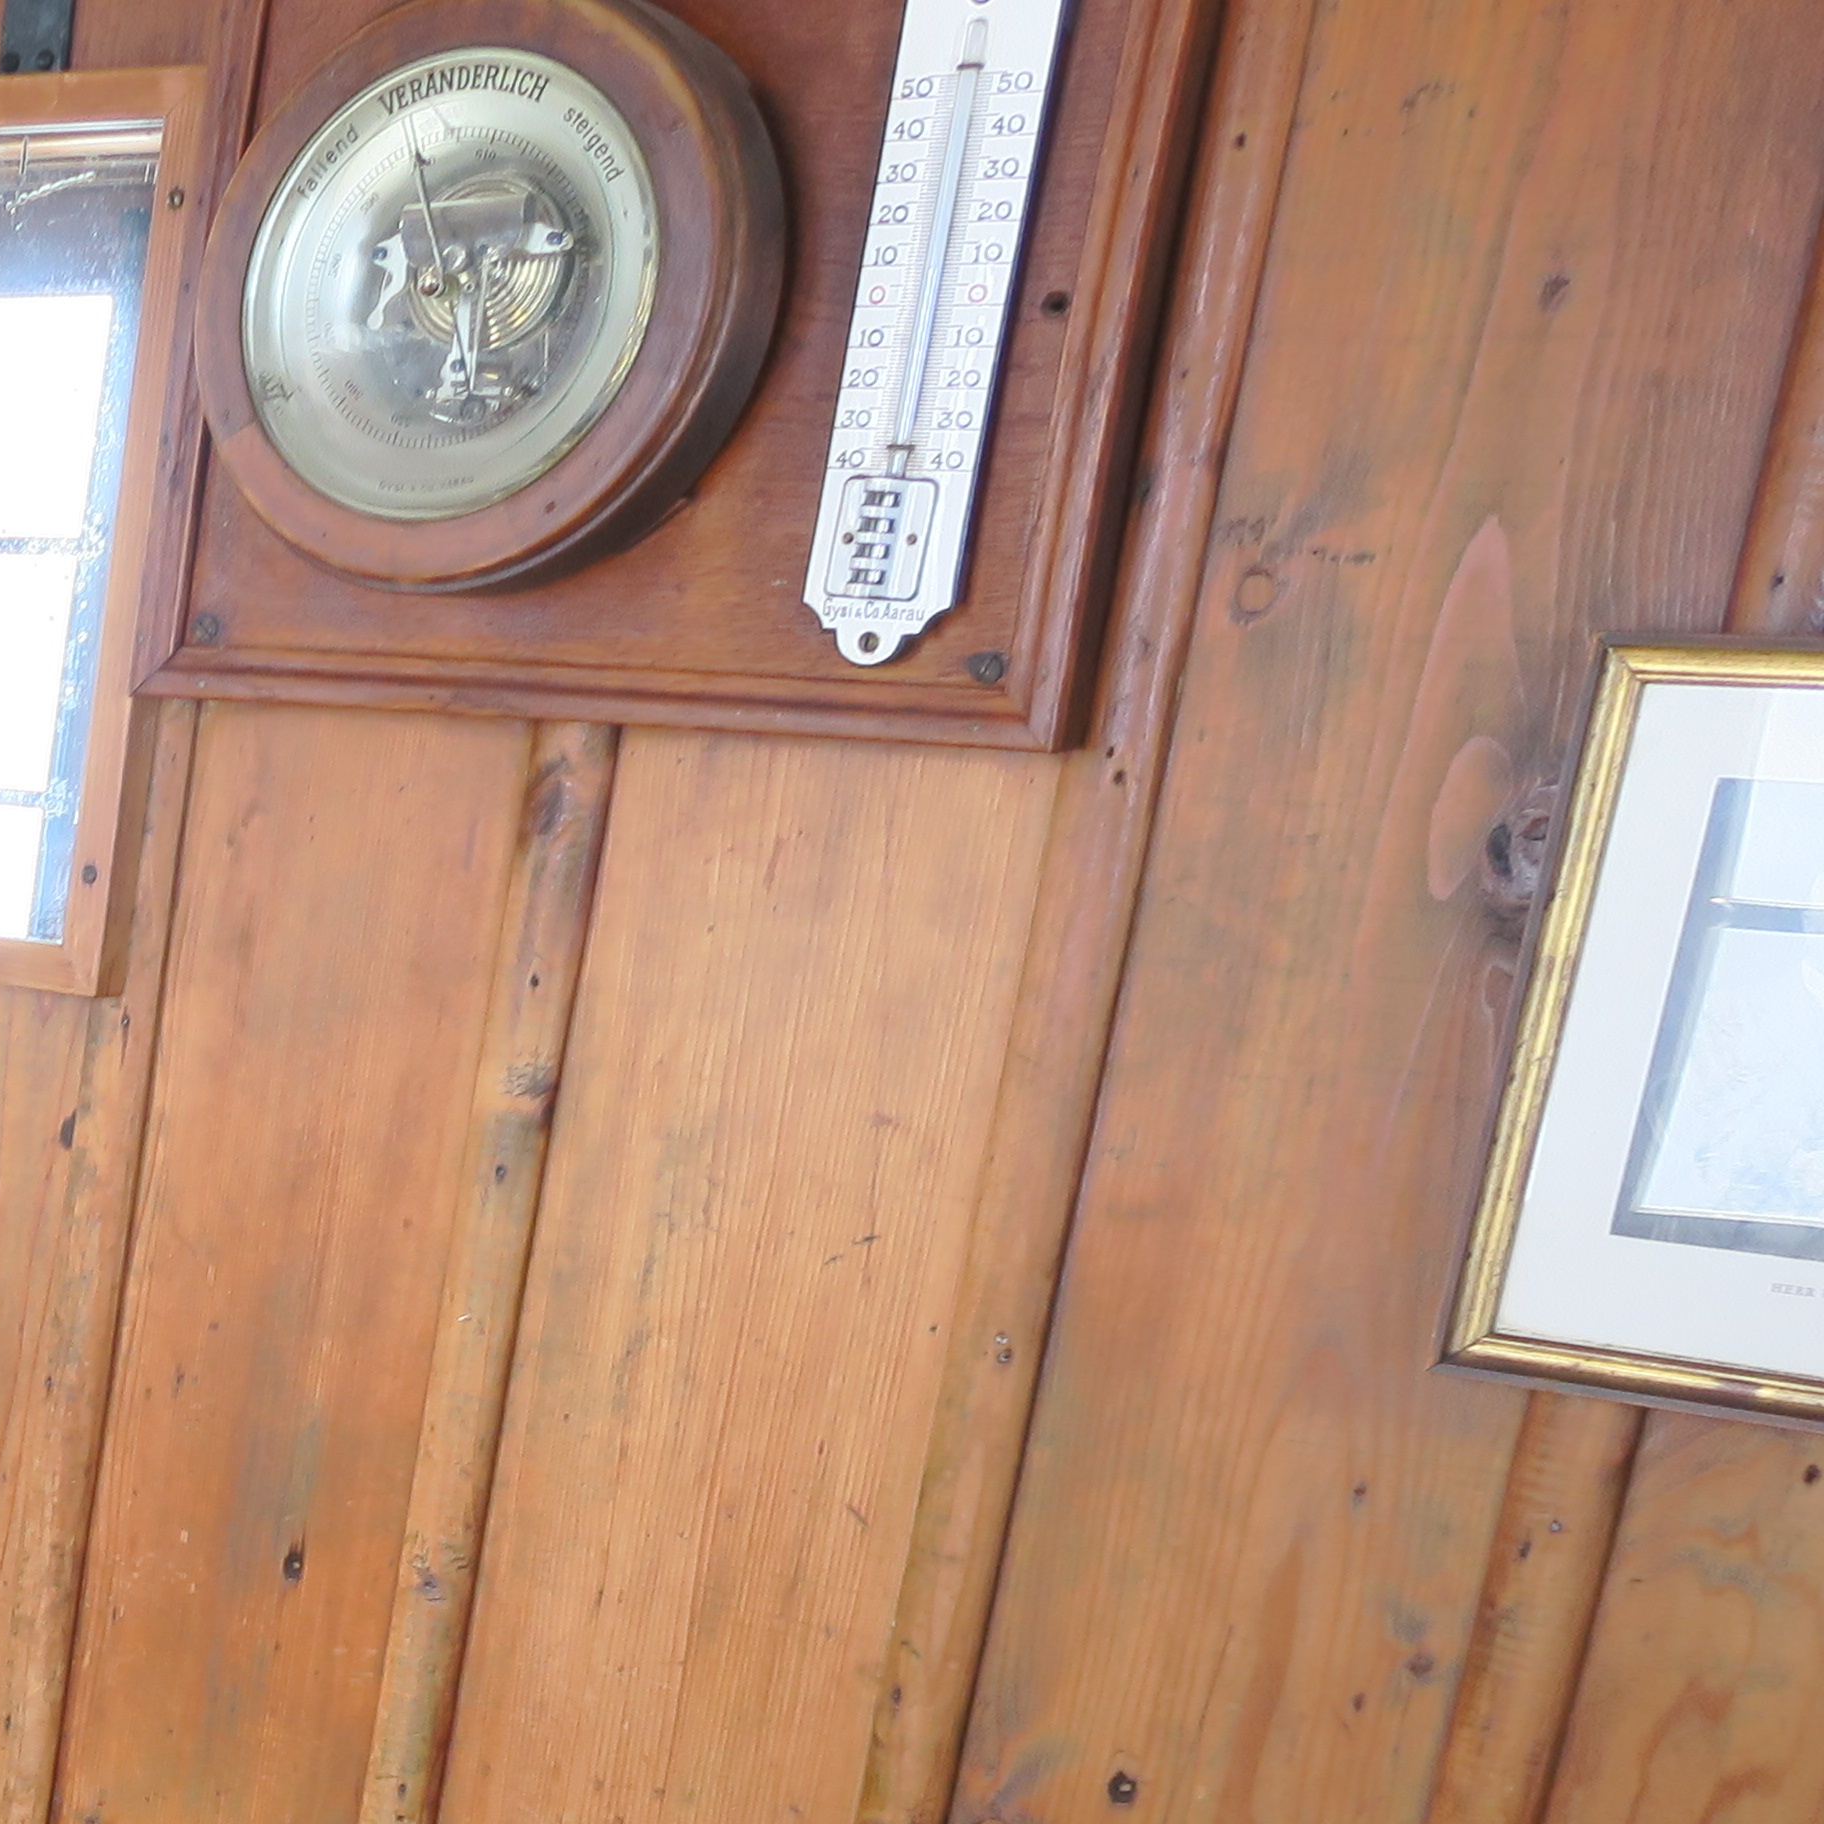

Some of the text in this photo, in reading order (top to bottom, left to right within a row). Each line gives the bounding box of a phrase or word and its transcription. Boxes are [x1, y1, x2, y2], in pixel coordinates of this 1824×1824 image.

[900, 76, 934, 98] 50
[996, 70, 1034, 93] 50
[893, 118, 925, 140] 40
[991, 113, 1026, 135] 40
[562, 106, 626, 184] steigend
[296, 123, 361, 200] fallend
[885, 161, 918, 184] 30
[983, 156, 1020, 179] 30
[878, 203, 910, 225] 20
[976, 200, 1013, 221] 20
[872, 244, 899, 267] 10
[971, 241, 1004, 264] 10
[868, 285, 887, 305] 0
[967, 282, 988, 304] 0
[858, 328, 885, 348] 10
[953, 326, 985, 348] 10
[847, 368, 880, 388] 20
[946, 368, 982, 388] 20
[840, 409, 873, 429] 30
[937, 409, 974, 430] 30
[835, 449, 866, 469] 40
[930, 450, 965, 470] 40
[822, 597, 853, 623] Gysi
[880, 602, 926, 622] Aarau
